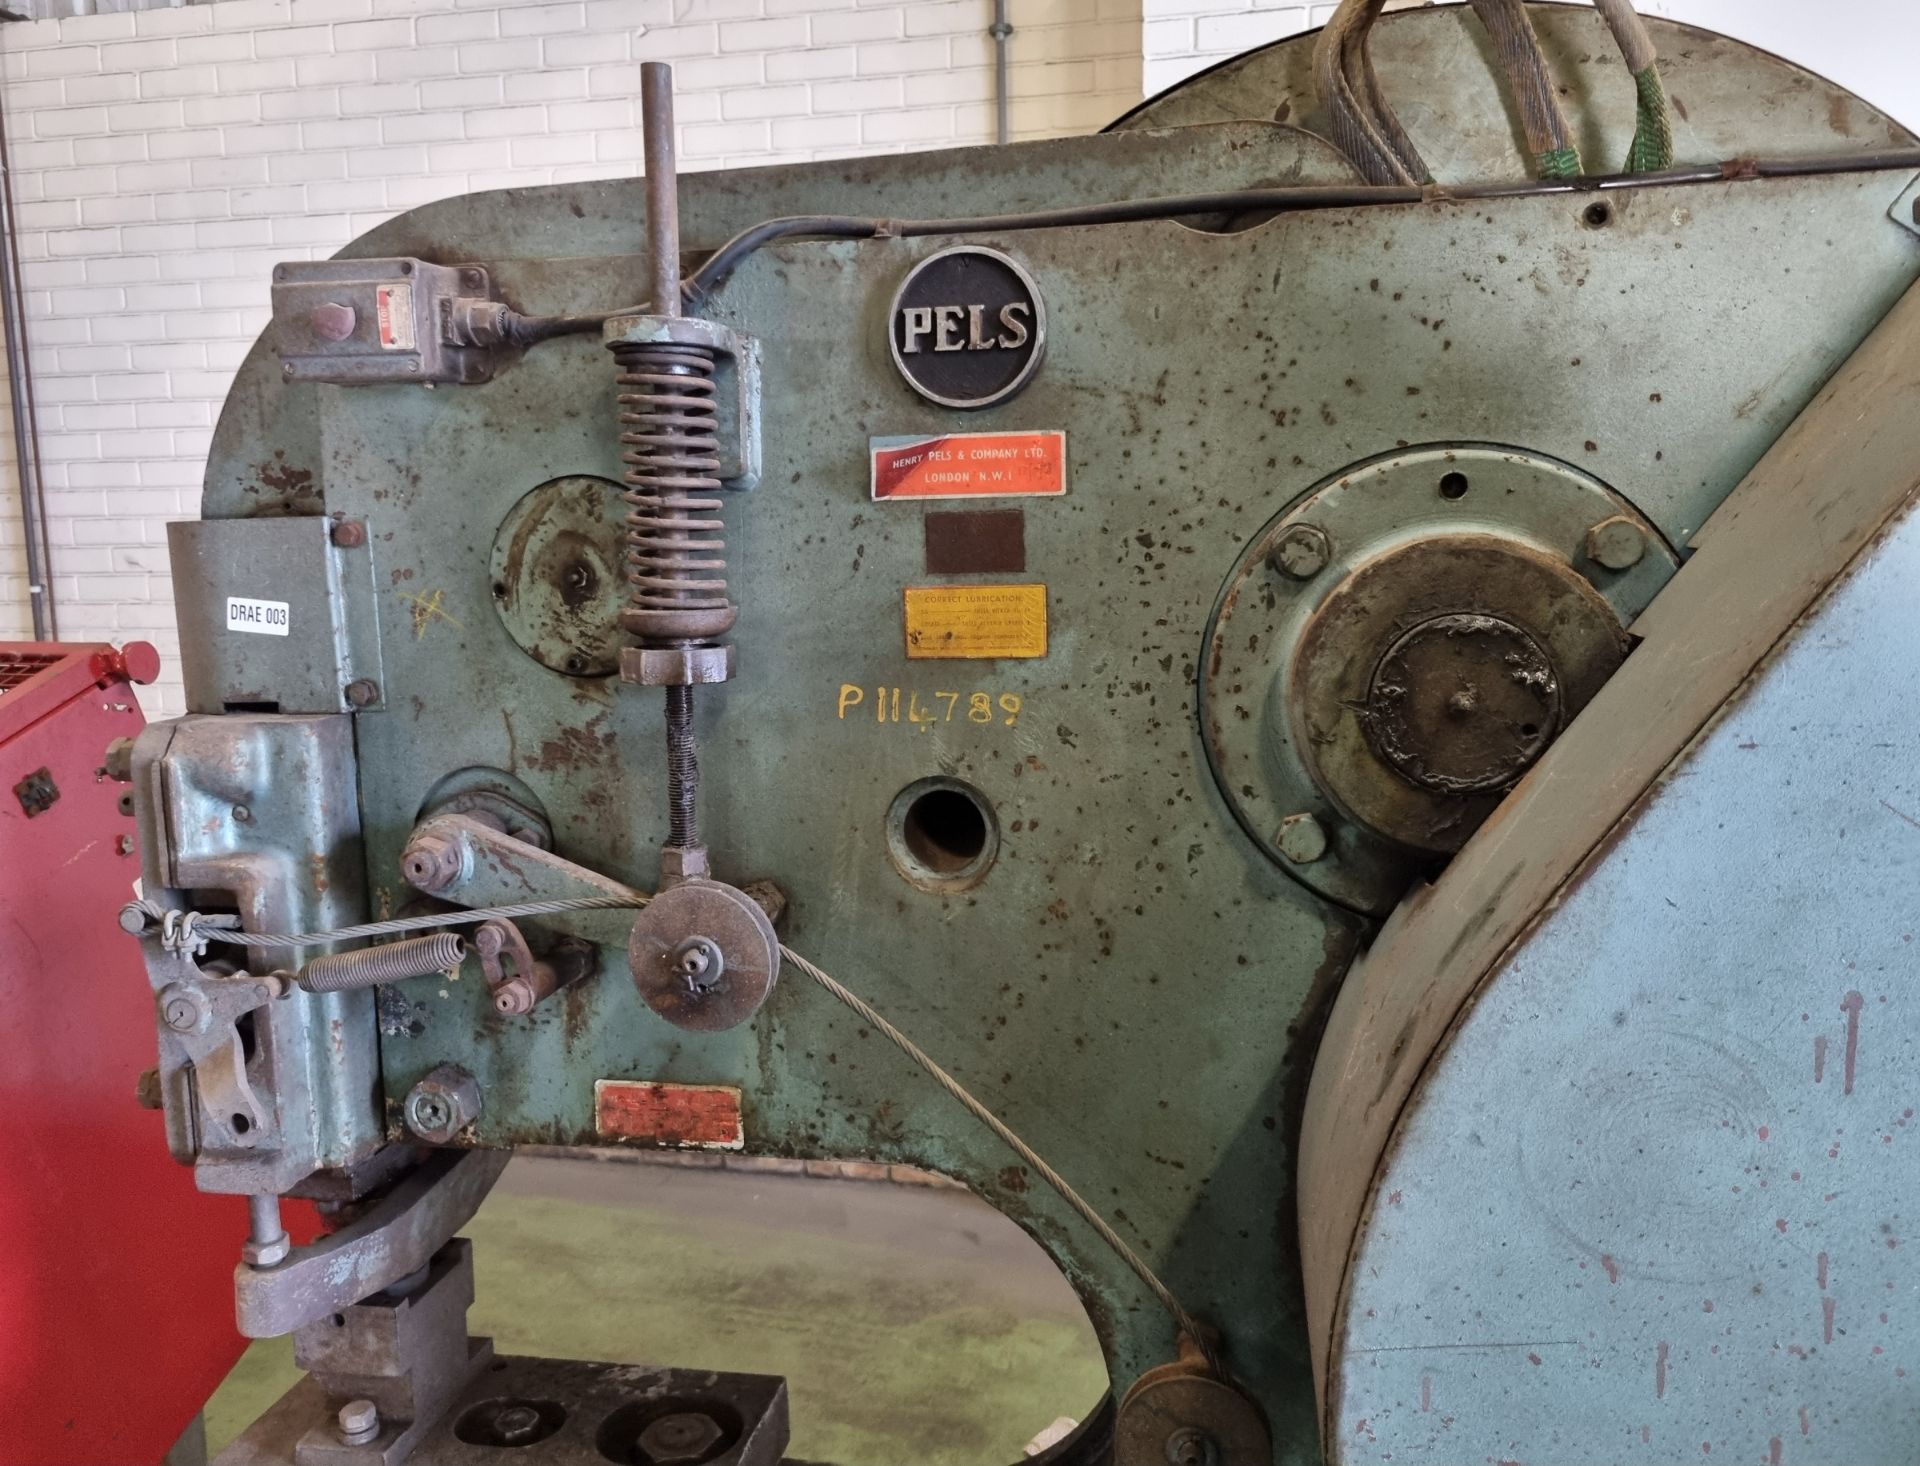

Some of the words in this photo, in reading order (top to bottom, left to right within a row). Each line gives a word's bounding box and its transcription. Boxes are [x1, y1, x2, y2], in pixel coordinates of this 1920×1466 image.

[902, 302, 1030, 353] PELS
[892, 454, 924, 469] HENRY
[928, 451, 952, 462] PELS
[957, 451, 965, 461] &
[970, 449, 1018, 460] COMPANY
[1024, 447, 1047, 458] LTD.
[925, 472, 970, 483] LONDON
[230, 604, 262, 622] DRAE
[266, 608, 286, 625] 003
